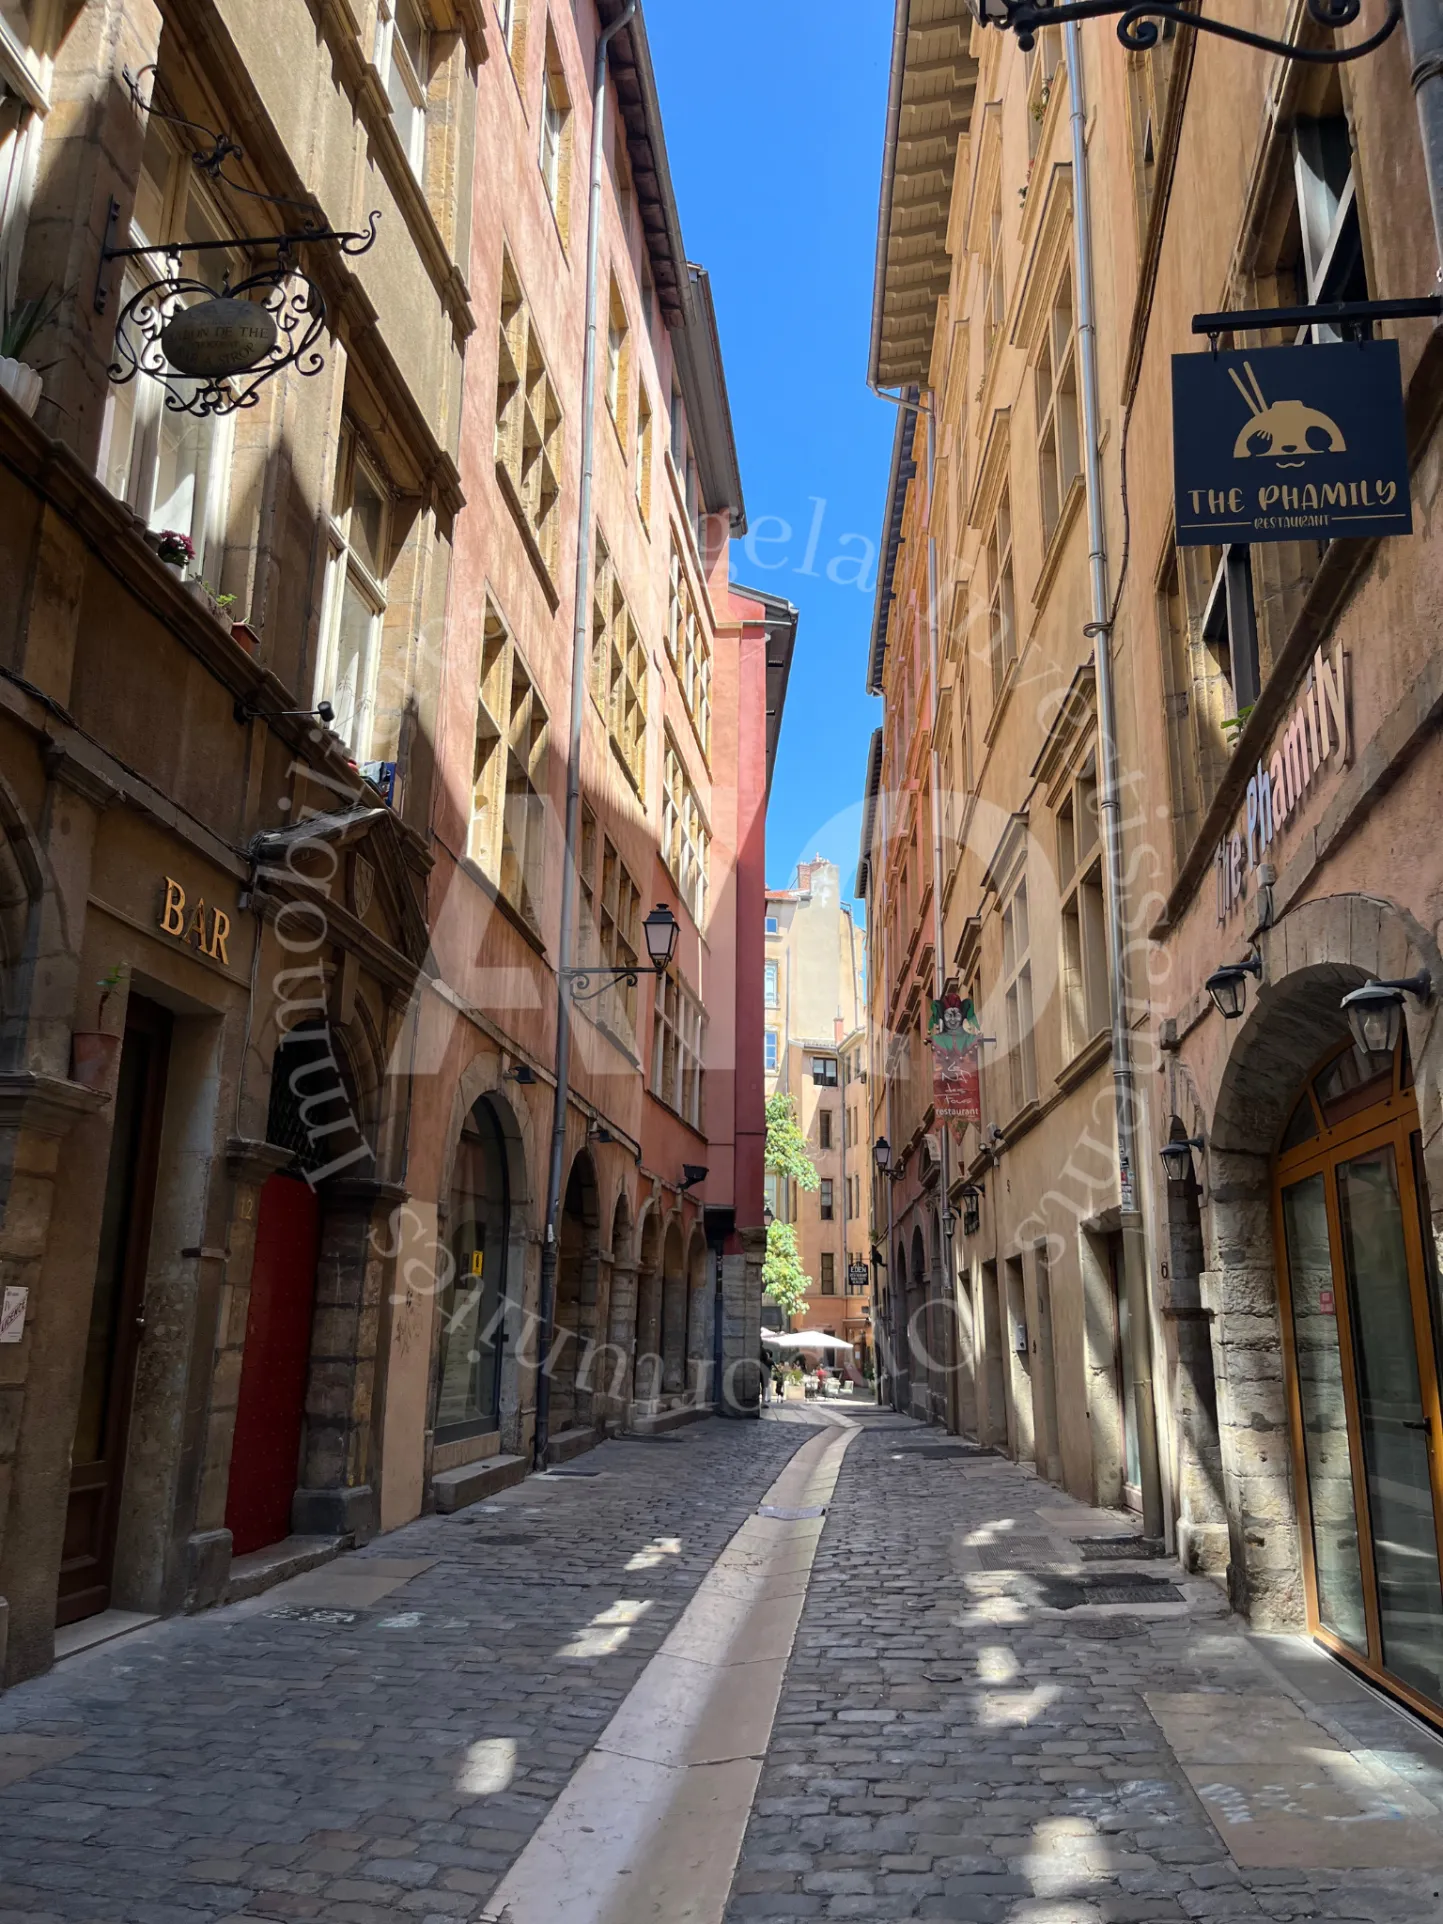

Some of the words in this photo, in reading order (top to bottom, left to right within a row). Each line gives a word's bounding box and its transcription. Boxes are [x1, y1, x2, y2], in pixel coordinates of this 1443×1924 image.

[240, 327, 269, 339] THE
[1188, 487, 1245, 515] THE
[1258, 479, 1397, 512] PHAMILY
[1254, 514, 1331, 530] RESTAURANT
[1247, 639, 1347, 875] Phamily
[160, 876, 230, 965] BAR
[935, 1108, 979, 1116] restaurant
